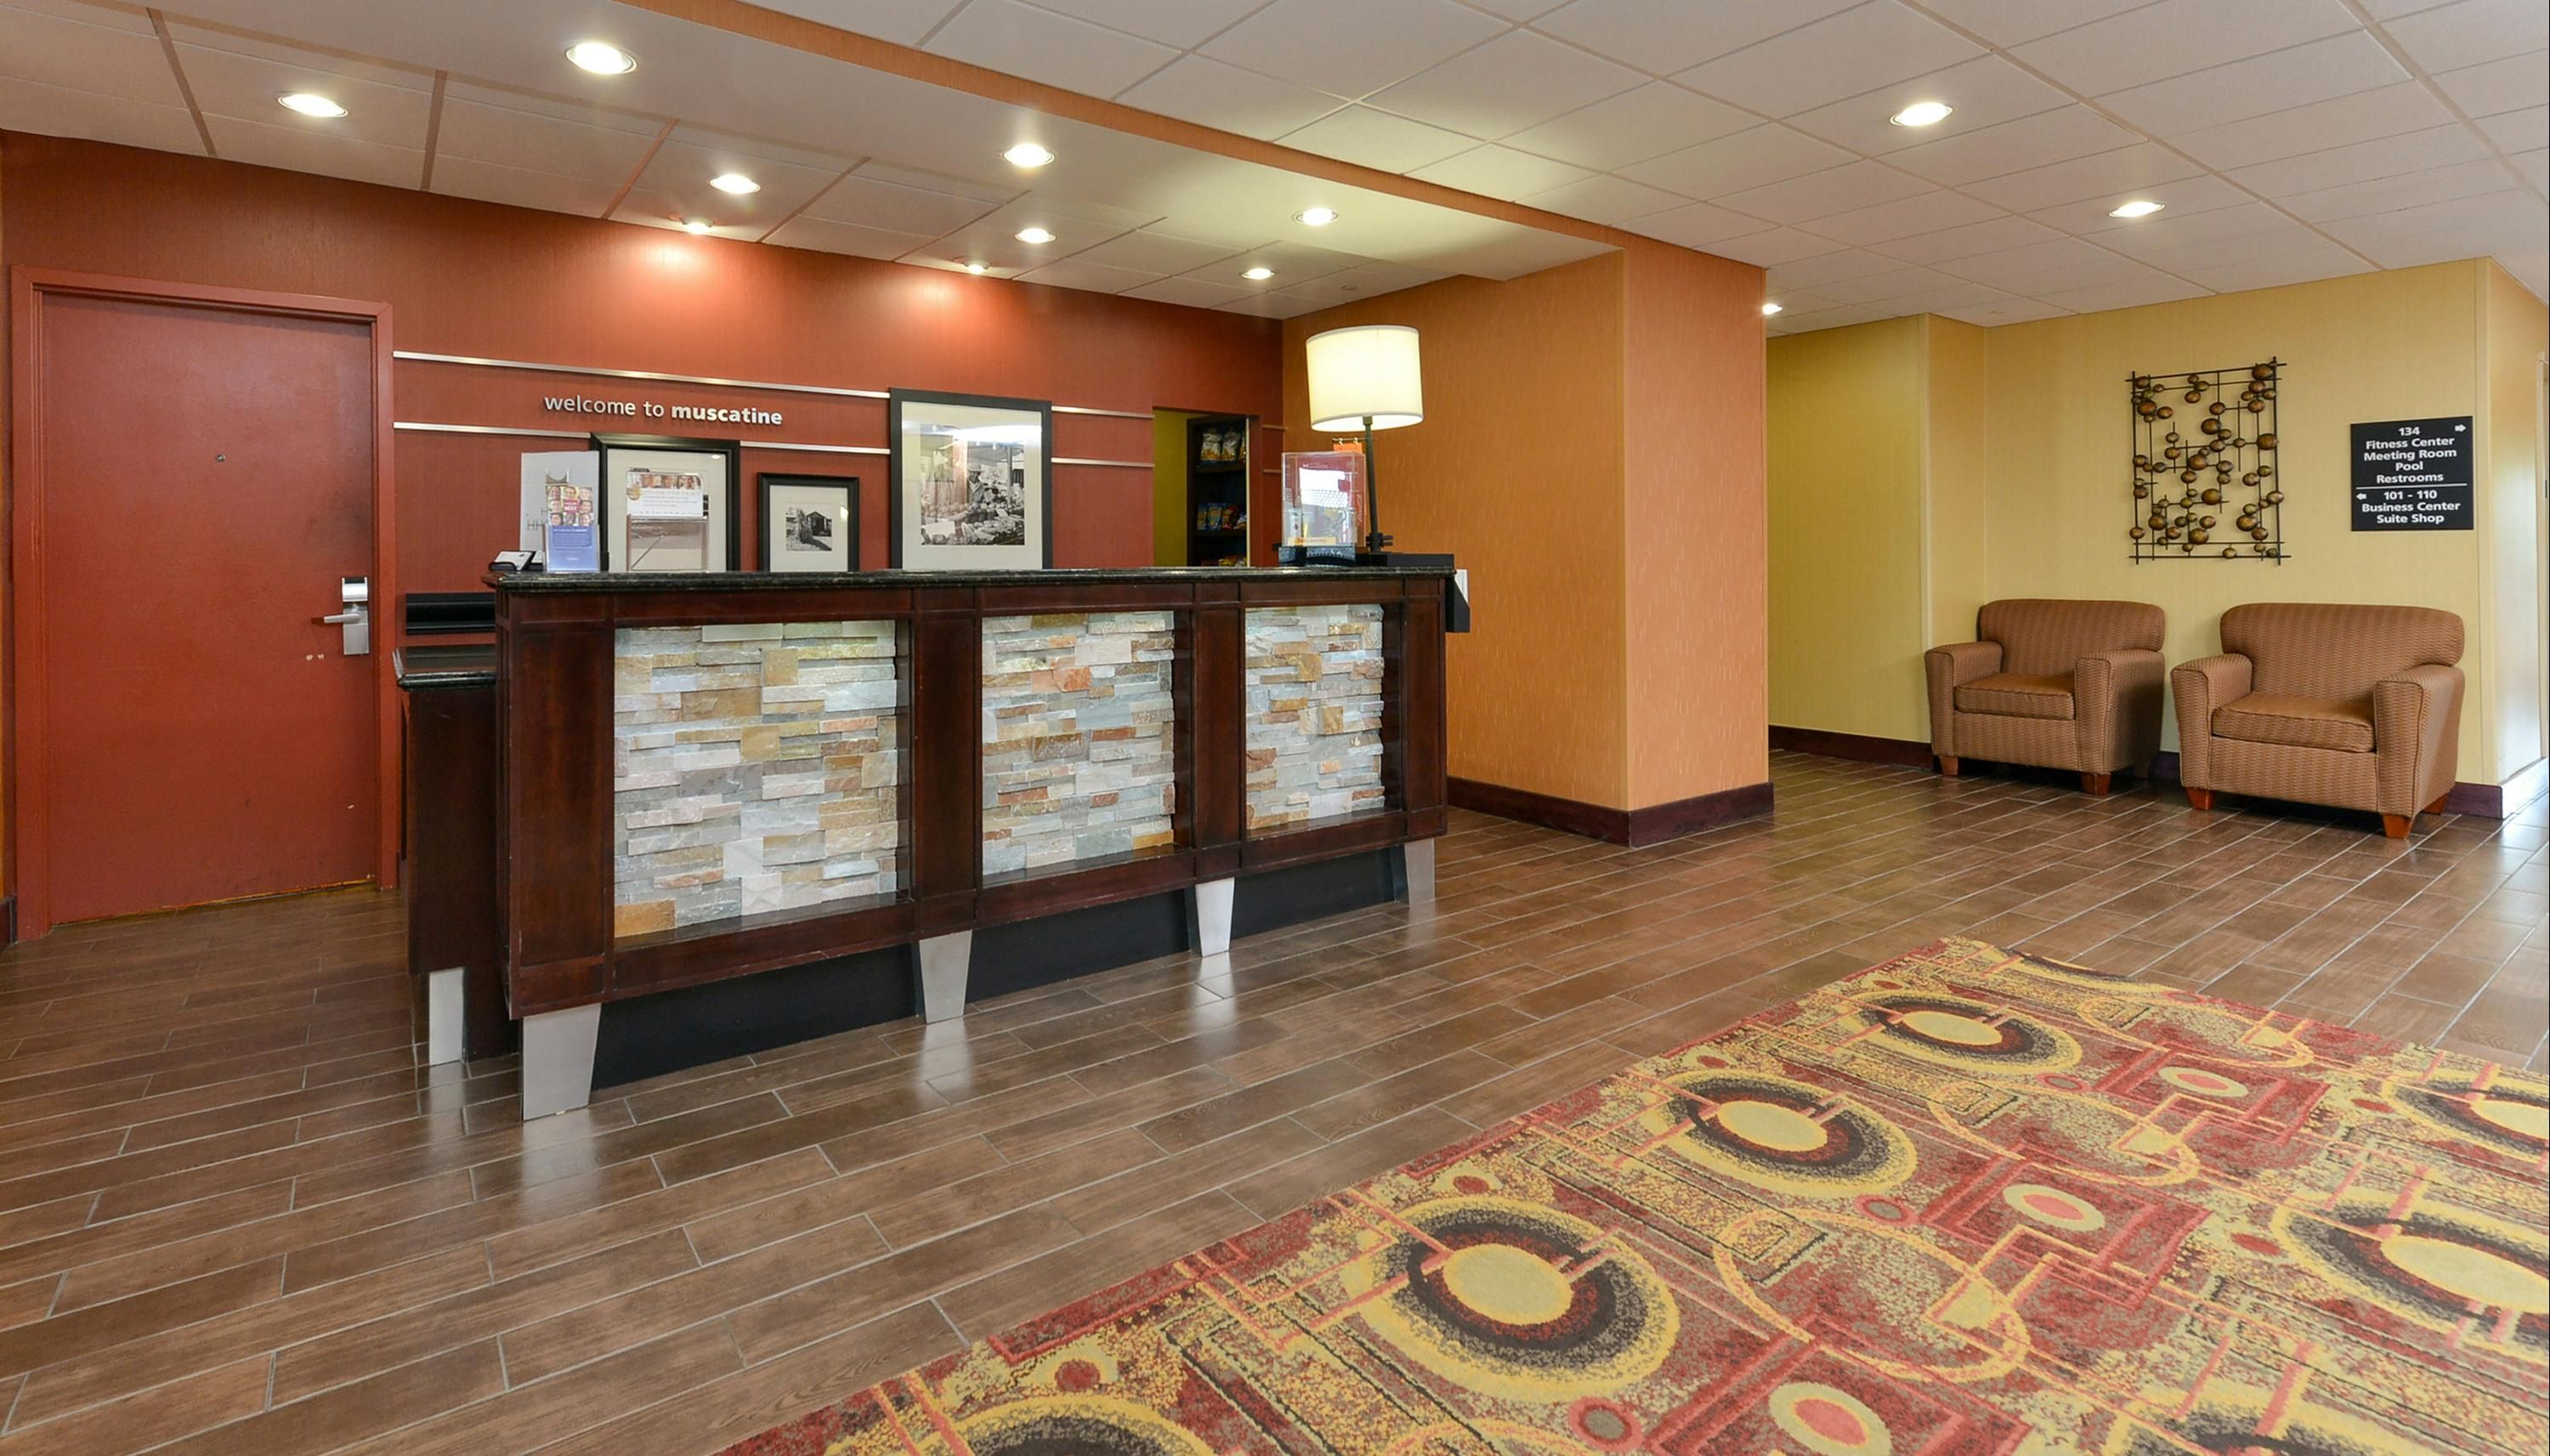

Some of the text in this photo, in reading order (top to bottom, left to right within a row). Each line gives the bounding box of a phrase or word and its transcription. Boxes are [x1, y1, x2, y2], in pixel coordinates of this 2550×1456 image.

[544, 394, 782, 425] welcome to muscatine
[2399, 427, 2420, 436] 134
[2366, 437, 2455, 450] Fitness Center
[2364, 449, 2457, 461] Meeting Room
[2395, 461, 2423, 472] Pool
[2377, 473, 2444, 484] Restrooms
[2383, 490, 2404, 501] 101
[2417, 490, 2438, 500] 110
[2361, 501, 2461, 513] Business Center
[2377, 513, 2445, 524] Suite Shop
